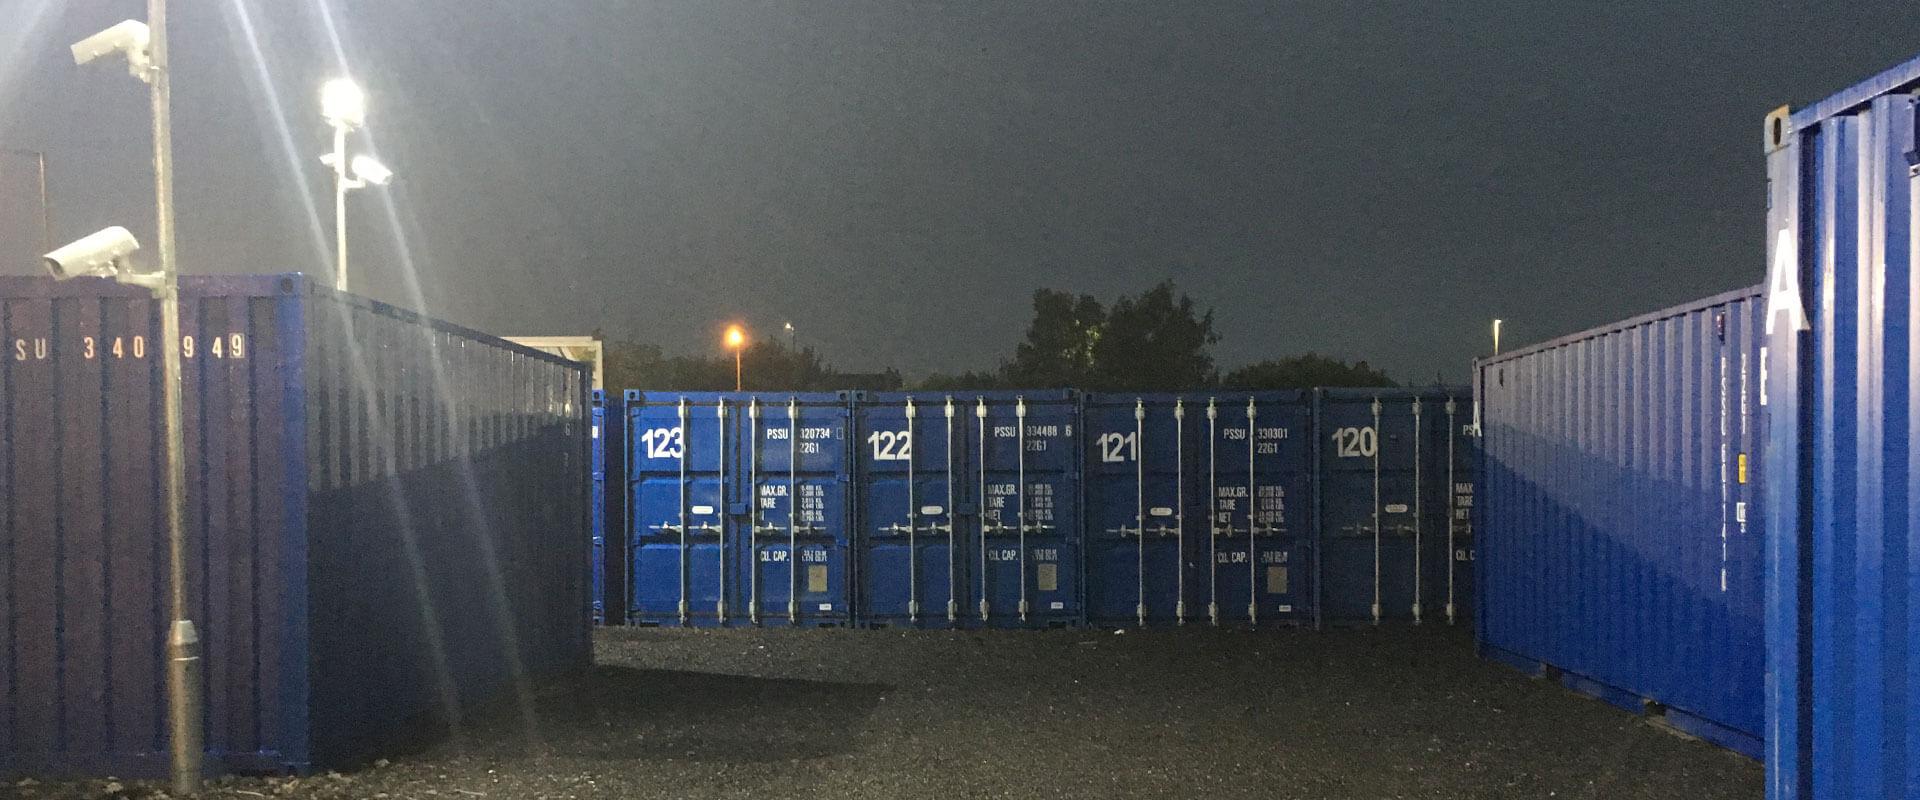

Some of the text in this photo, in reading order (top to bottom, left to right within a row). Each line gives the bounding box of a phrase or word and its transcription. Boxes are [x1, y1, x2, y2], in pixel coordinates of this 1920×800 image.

[1766, 228, 1811, 335] A
[767, 428, 789, 440] PSSU
[994, 426, 1016, 438] PSSU
[1223, 428, 1246, 440] PSSU
[1472, 400, 1483, 437] A
[641, 427, 686, 458] 123
[867, 431, 912, 461] 122
[1096, 431, 1137, 462] 121
[1331, 426, 1378, 457] 120
